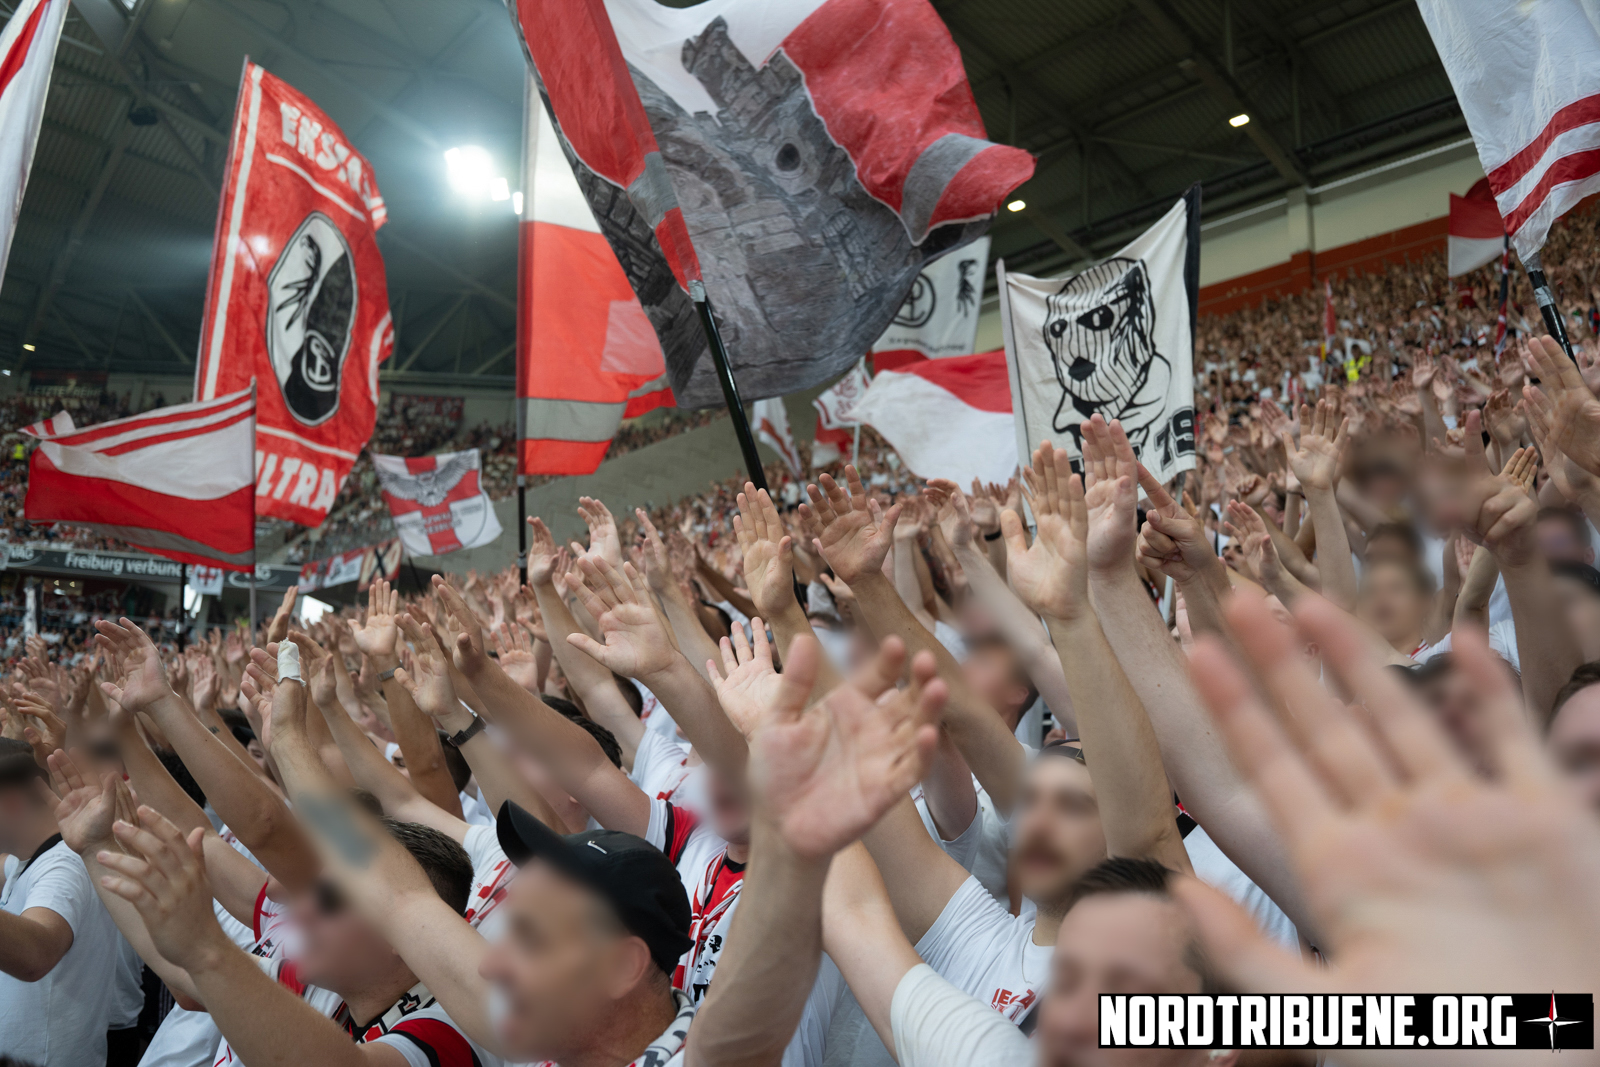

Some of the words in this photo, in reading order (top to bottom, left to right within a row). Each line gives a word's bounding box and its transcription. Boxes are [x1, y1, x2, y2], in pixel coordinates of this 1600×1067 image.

[1154, 406, 1196, 471] 79
[256, 450, 347, 513] LTRA
[64, 551, 124, 575] Freiburg
